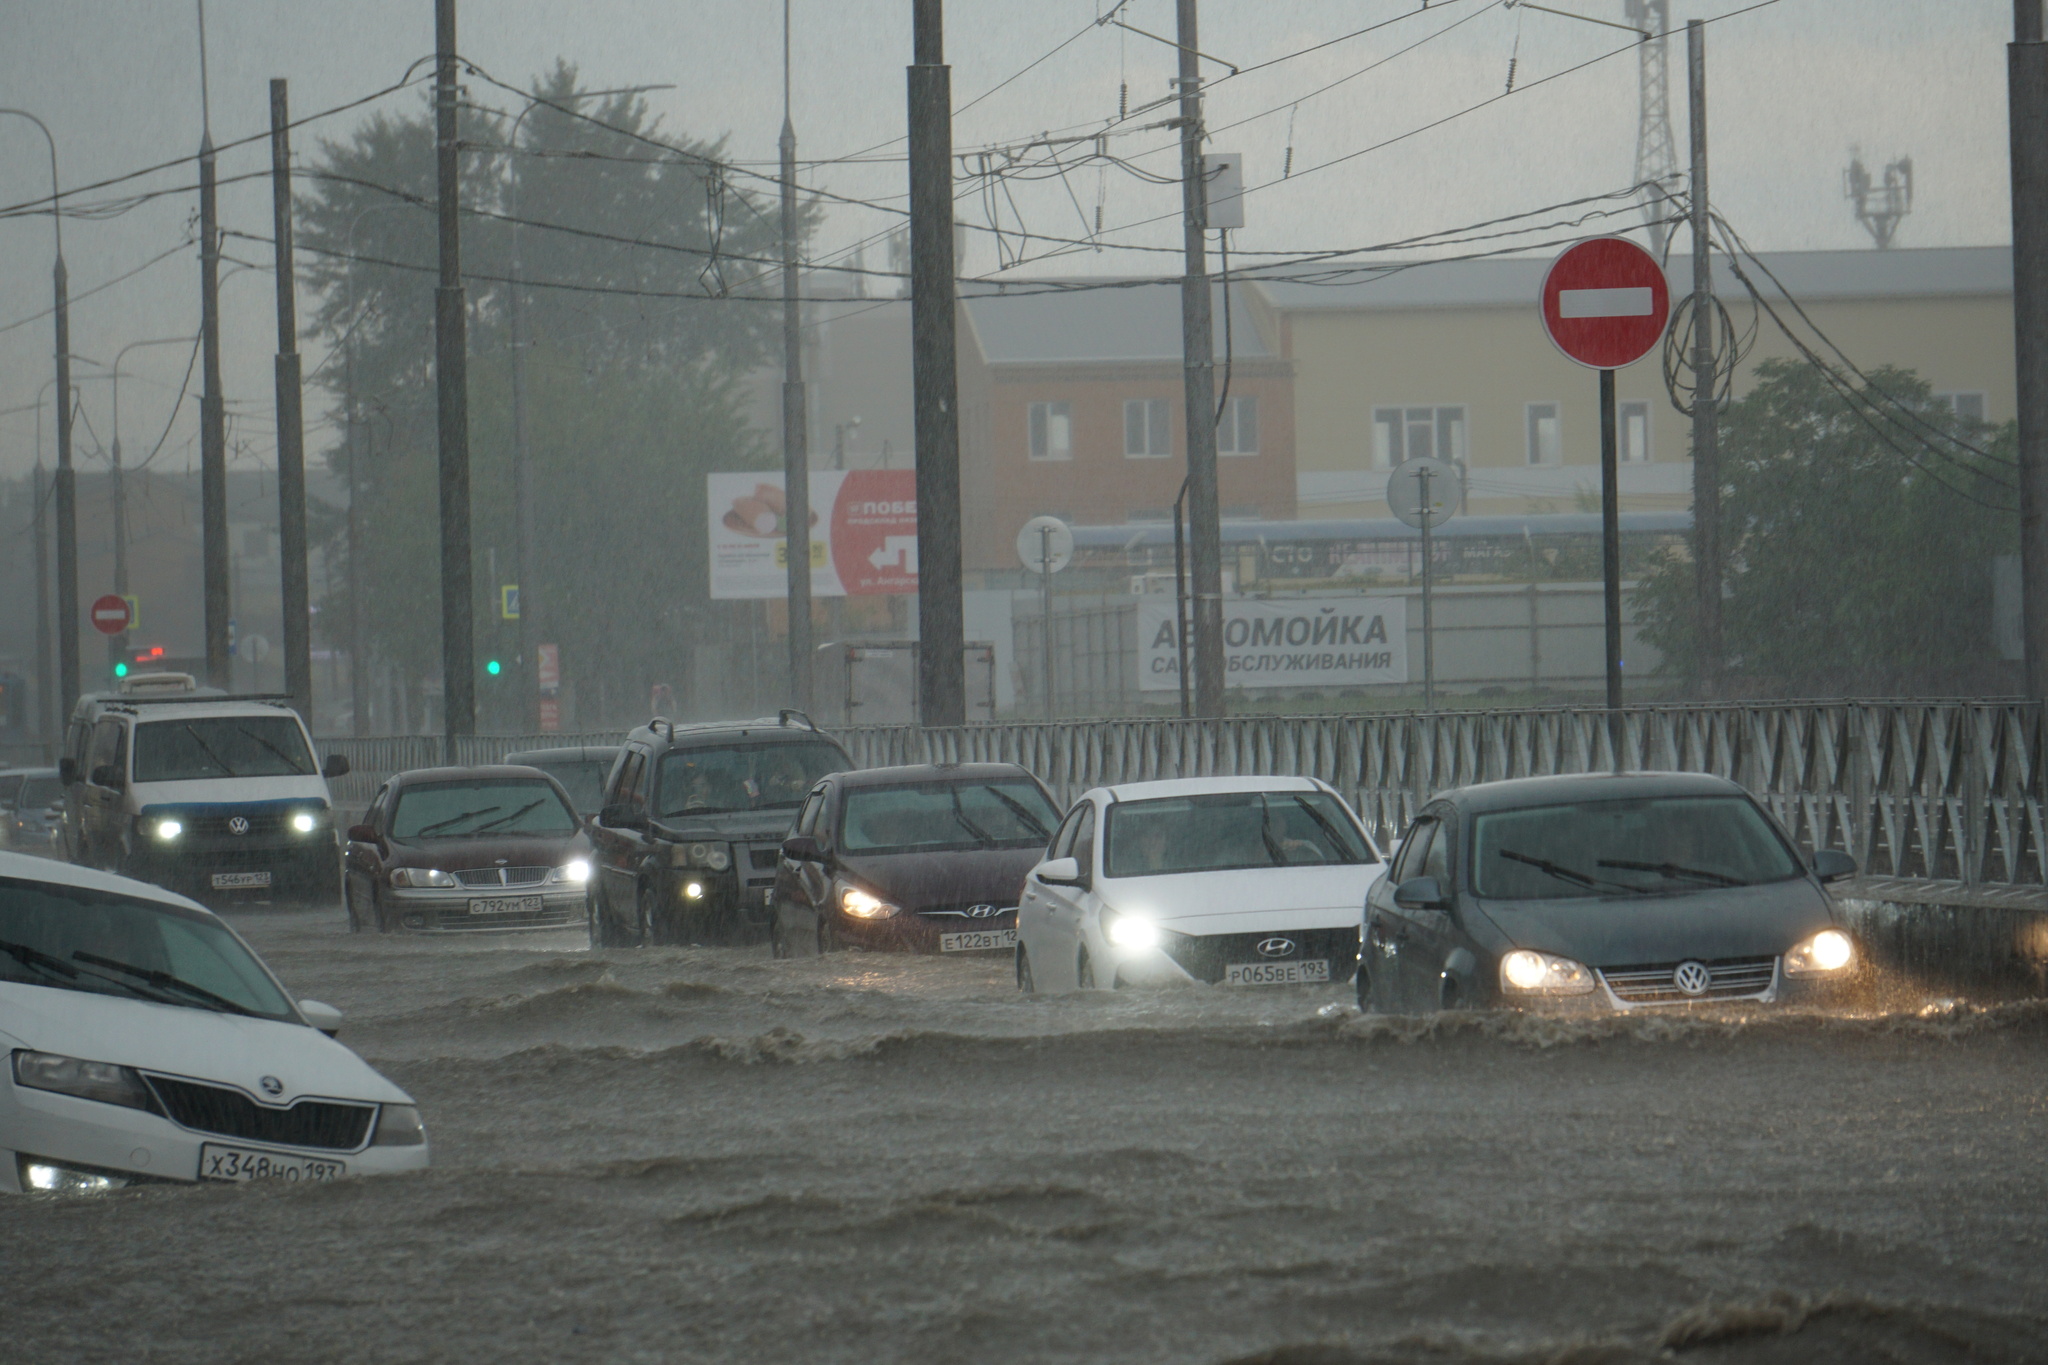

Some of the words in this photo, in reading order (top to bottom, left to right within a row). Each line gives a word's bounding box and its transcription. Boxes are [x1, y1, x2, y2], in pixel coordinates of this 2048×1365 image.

[1272, 546, 1313, 563] СТО
[1151, 608, 1388, 649] АОМОЙКА
[1151, 651, 1392, 673] САБСЛУЖИВАНИЯ
